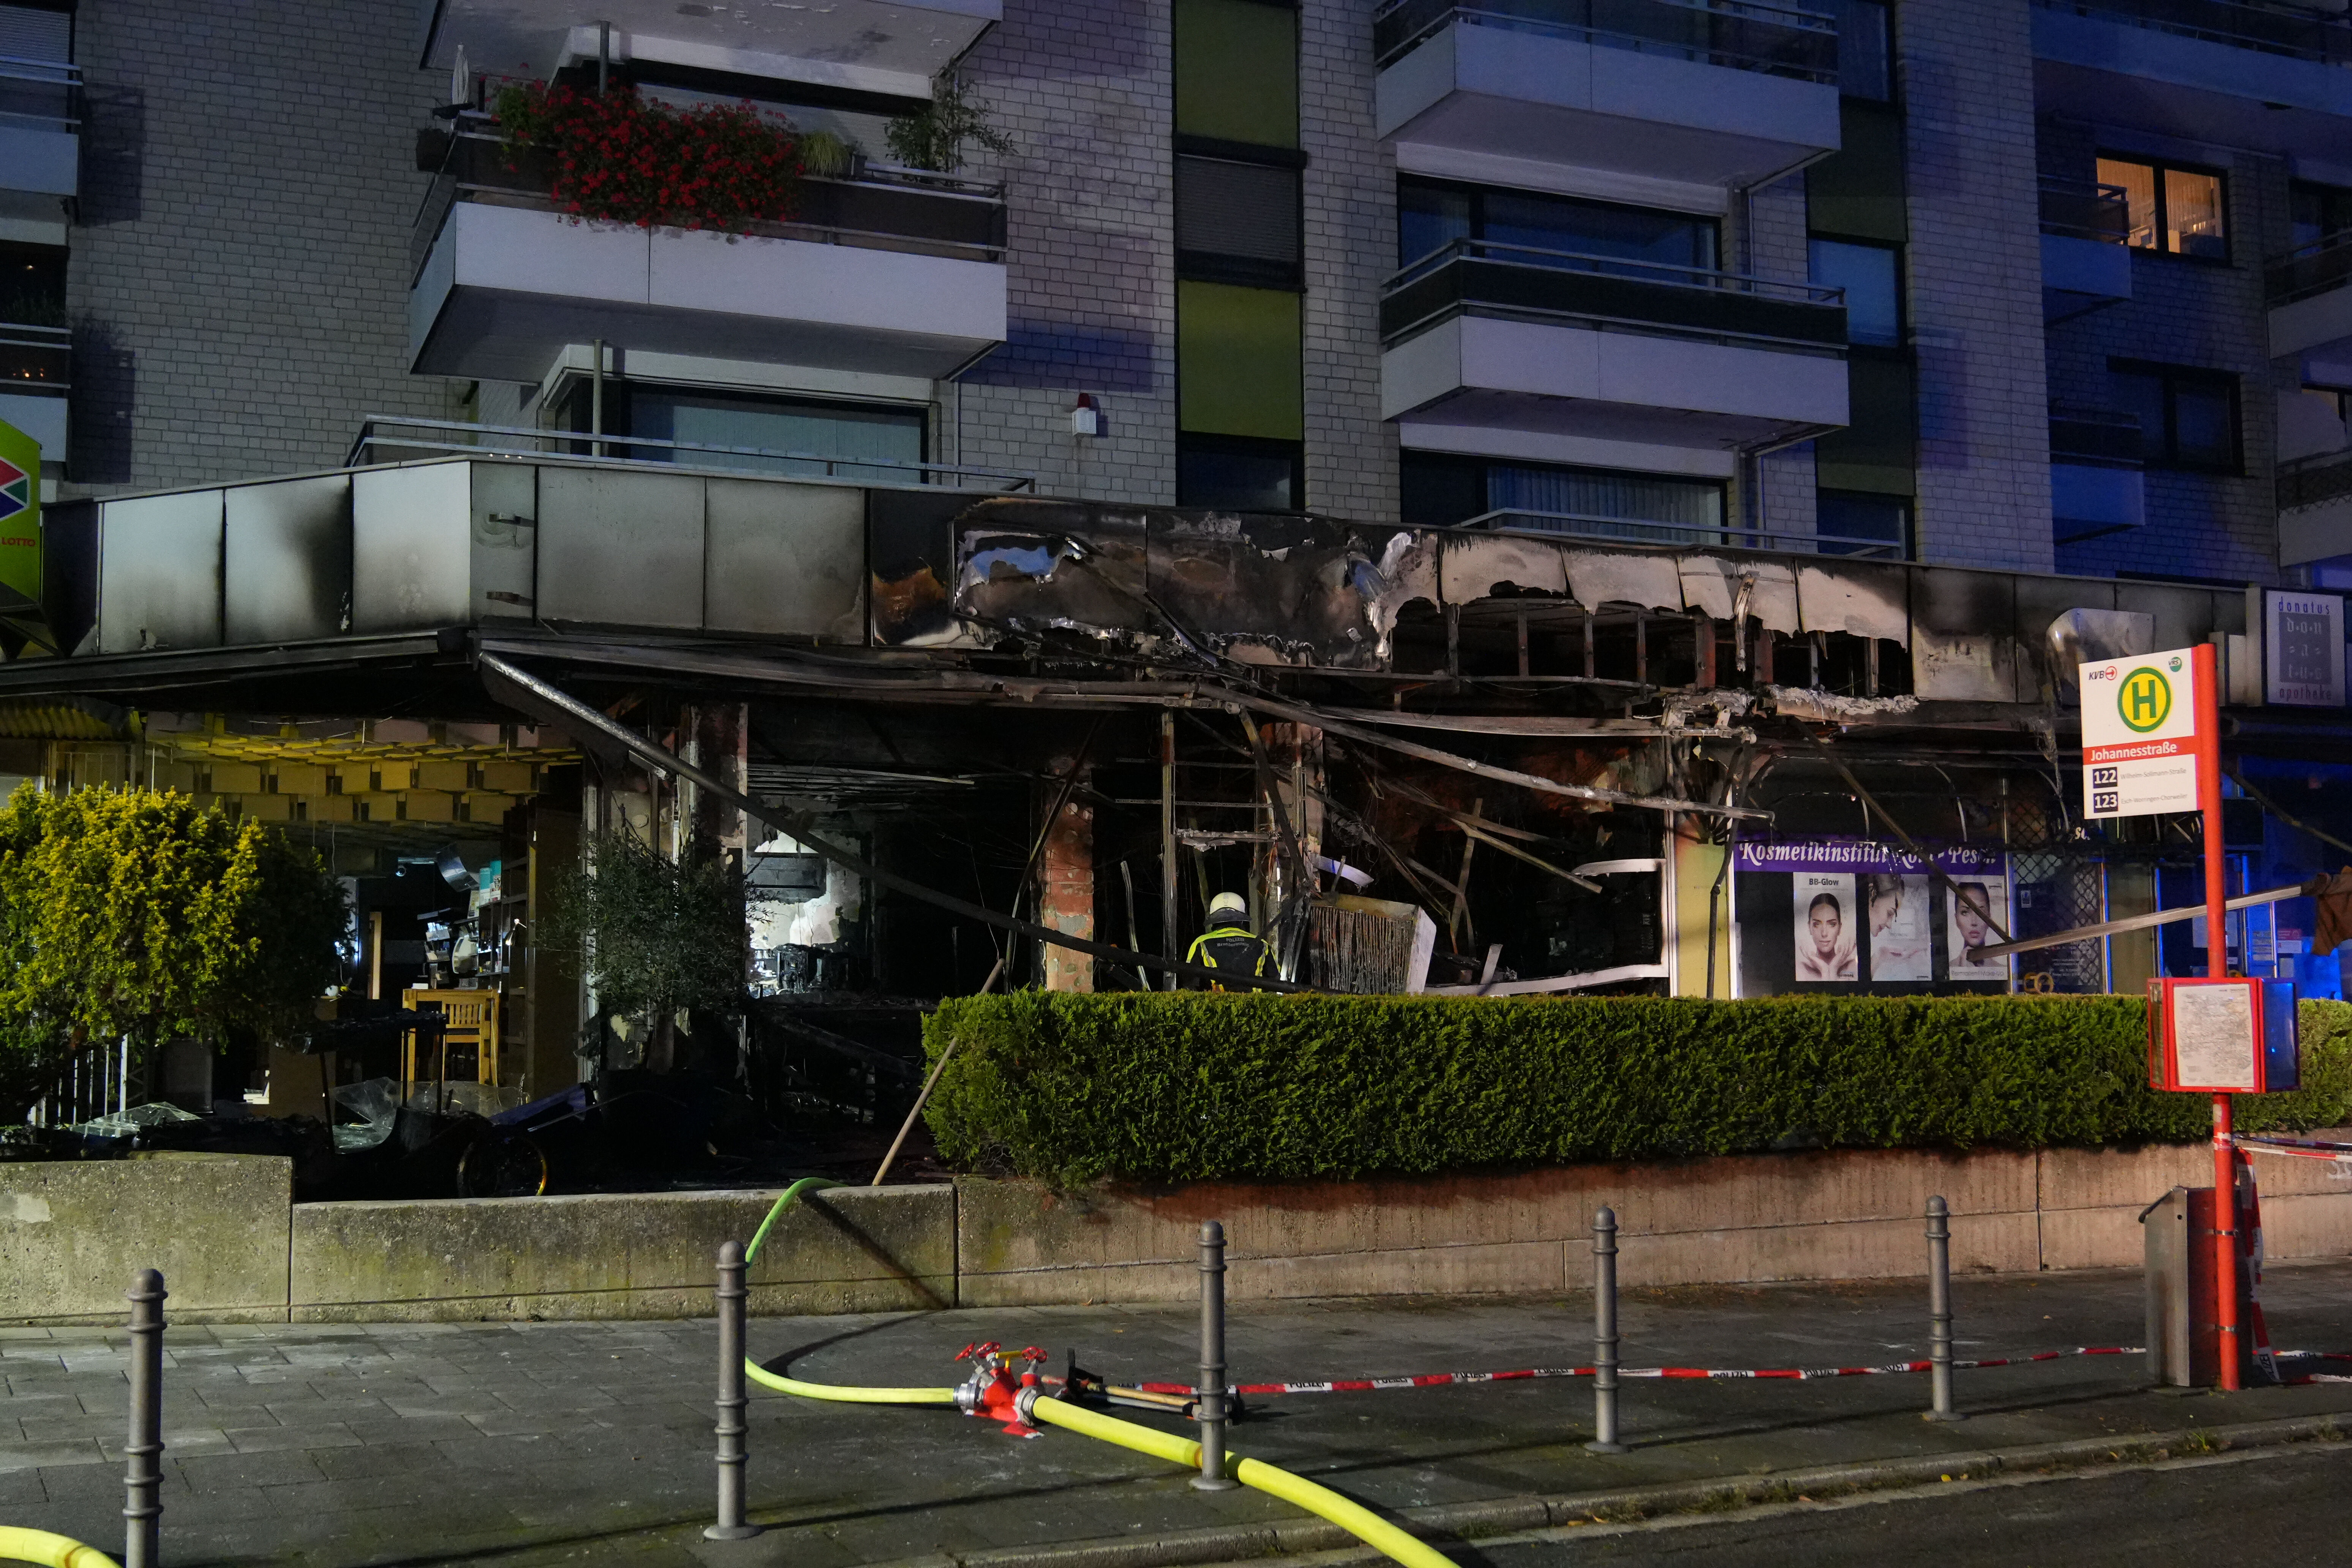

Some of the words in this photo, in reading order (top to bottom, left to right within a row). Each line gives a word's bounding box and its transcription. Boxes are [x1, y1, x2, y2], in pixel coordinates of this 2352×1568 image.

[2, 536, 36, 547] LOTTO
[2278, 596, 2330, 615] donatus
[2088, 670, 2105, 681] KVB
[2279, 685, 2332, 702] apotheke
[2091, 741, 2177, 761] Johannesstraße
[2094, 769, 2117, 784] 122
[2094, 794, 2117, 809] 123
